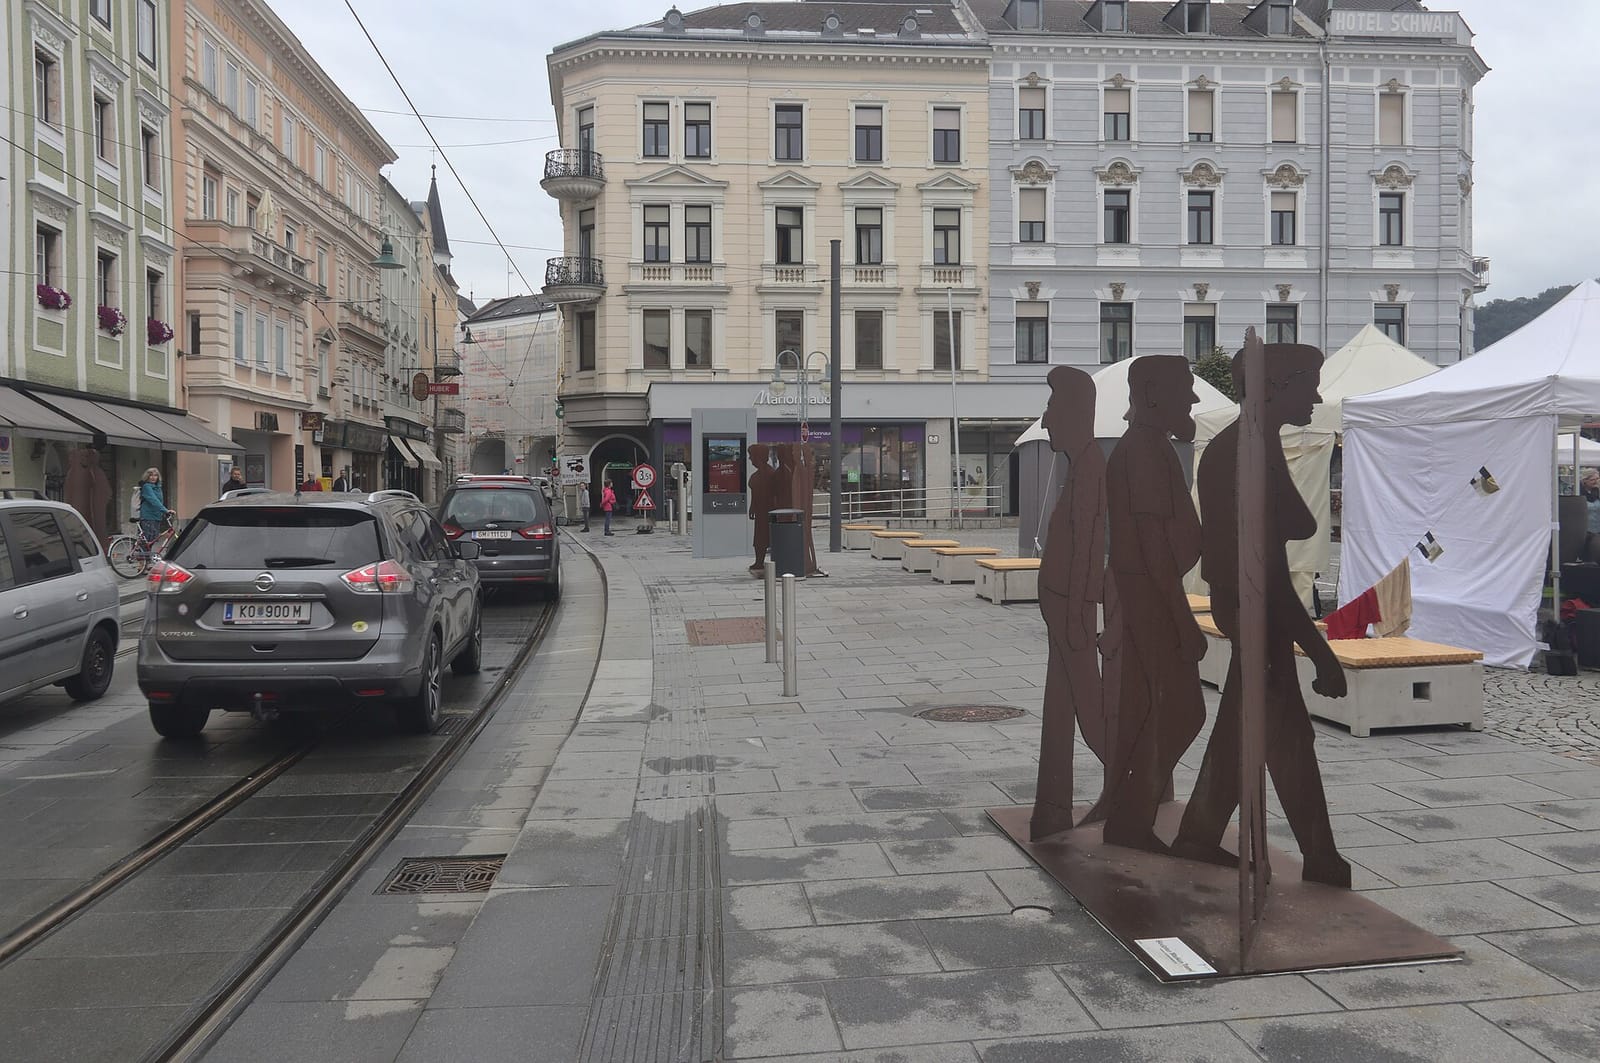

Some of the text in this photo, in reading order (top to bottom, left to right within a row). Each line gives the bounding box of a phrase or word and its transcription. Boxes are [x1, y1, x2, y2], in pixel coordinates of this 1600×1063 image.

[213, 4, 250, 54] HOTEL
[1335, 13, 1454, 33] HOTEL SCHWAN
[752, 389, 831, 407] Marionaud
[240, 605, 302, 618] KO 900 M
